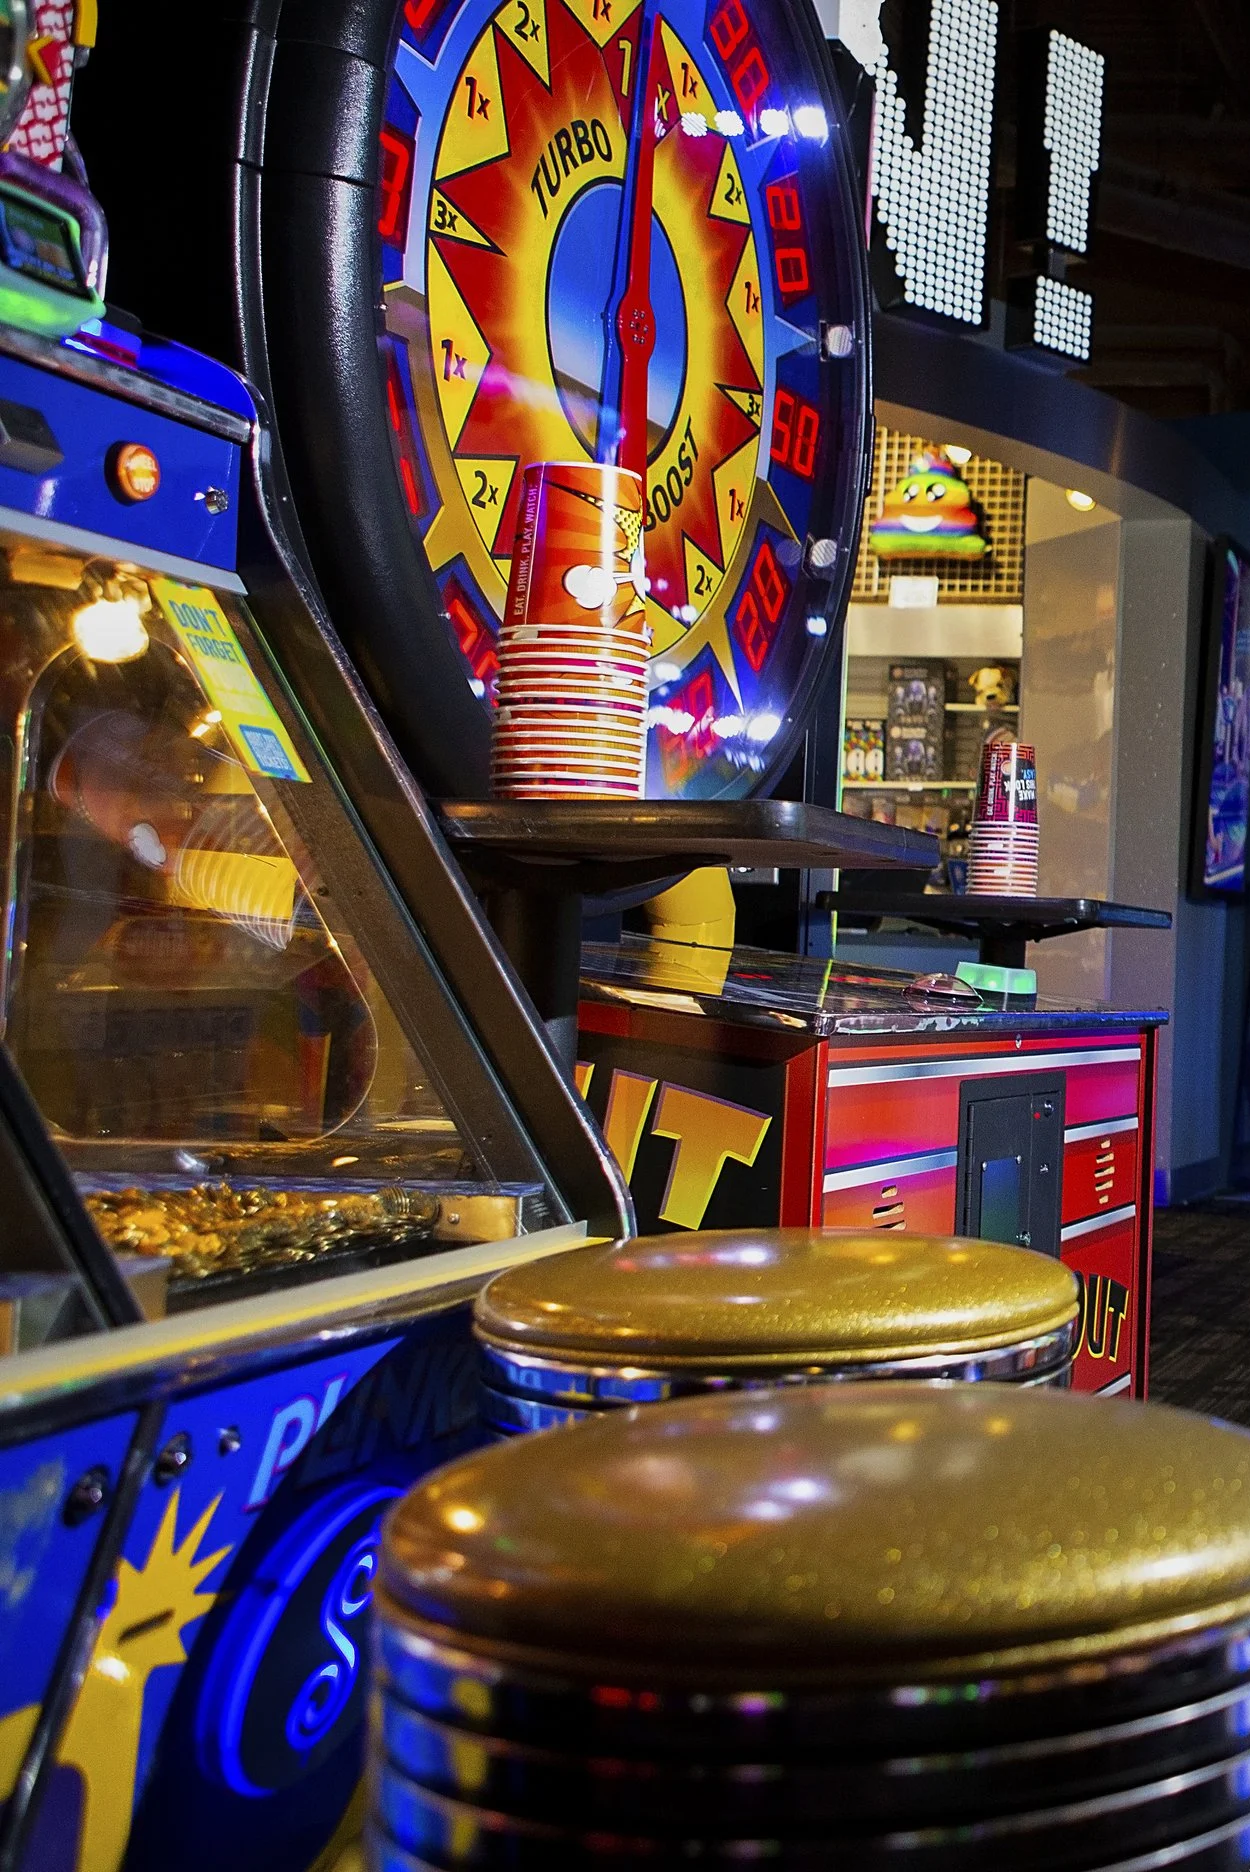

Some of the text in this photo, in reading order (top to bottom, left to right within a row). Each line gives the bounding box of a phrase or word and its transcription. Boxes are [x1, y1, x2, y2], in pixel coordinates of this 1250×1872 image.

[514, 1, 540, 42] 2x
[680, 61, 698, 99] 1x
[465, 76, 492, 121] 1x
[531, 118, 613, 220] TURBO
[724, 173, 743, 206] 2x
[433, 199, 458, 233] 3x
[744, 281, 760, 314] 1x
[441, 338, 467, 383] 1x
[747, 393, 761, 417] 3x
[471, 470, 499, 510] 2x
[729, 488, 745, 521] 1x
[521, 525, 534, 554] PLAY.
[517, 555, 530, 592] DRINK.
[694, 564, 713, 597] 2x
[168, 600, 226, 638] DON'T
[513, 595, 526, 616] EAT.
[186, 633, 241, 664] FORGET
[1004, 779, 1025, 793] LOK
